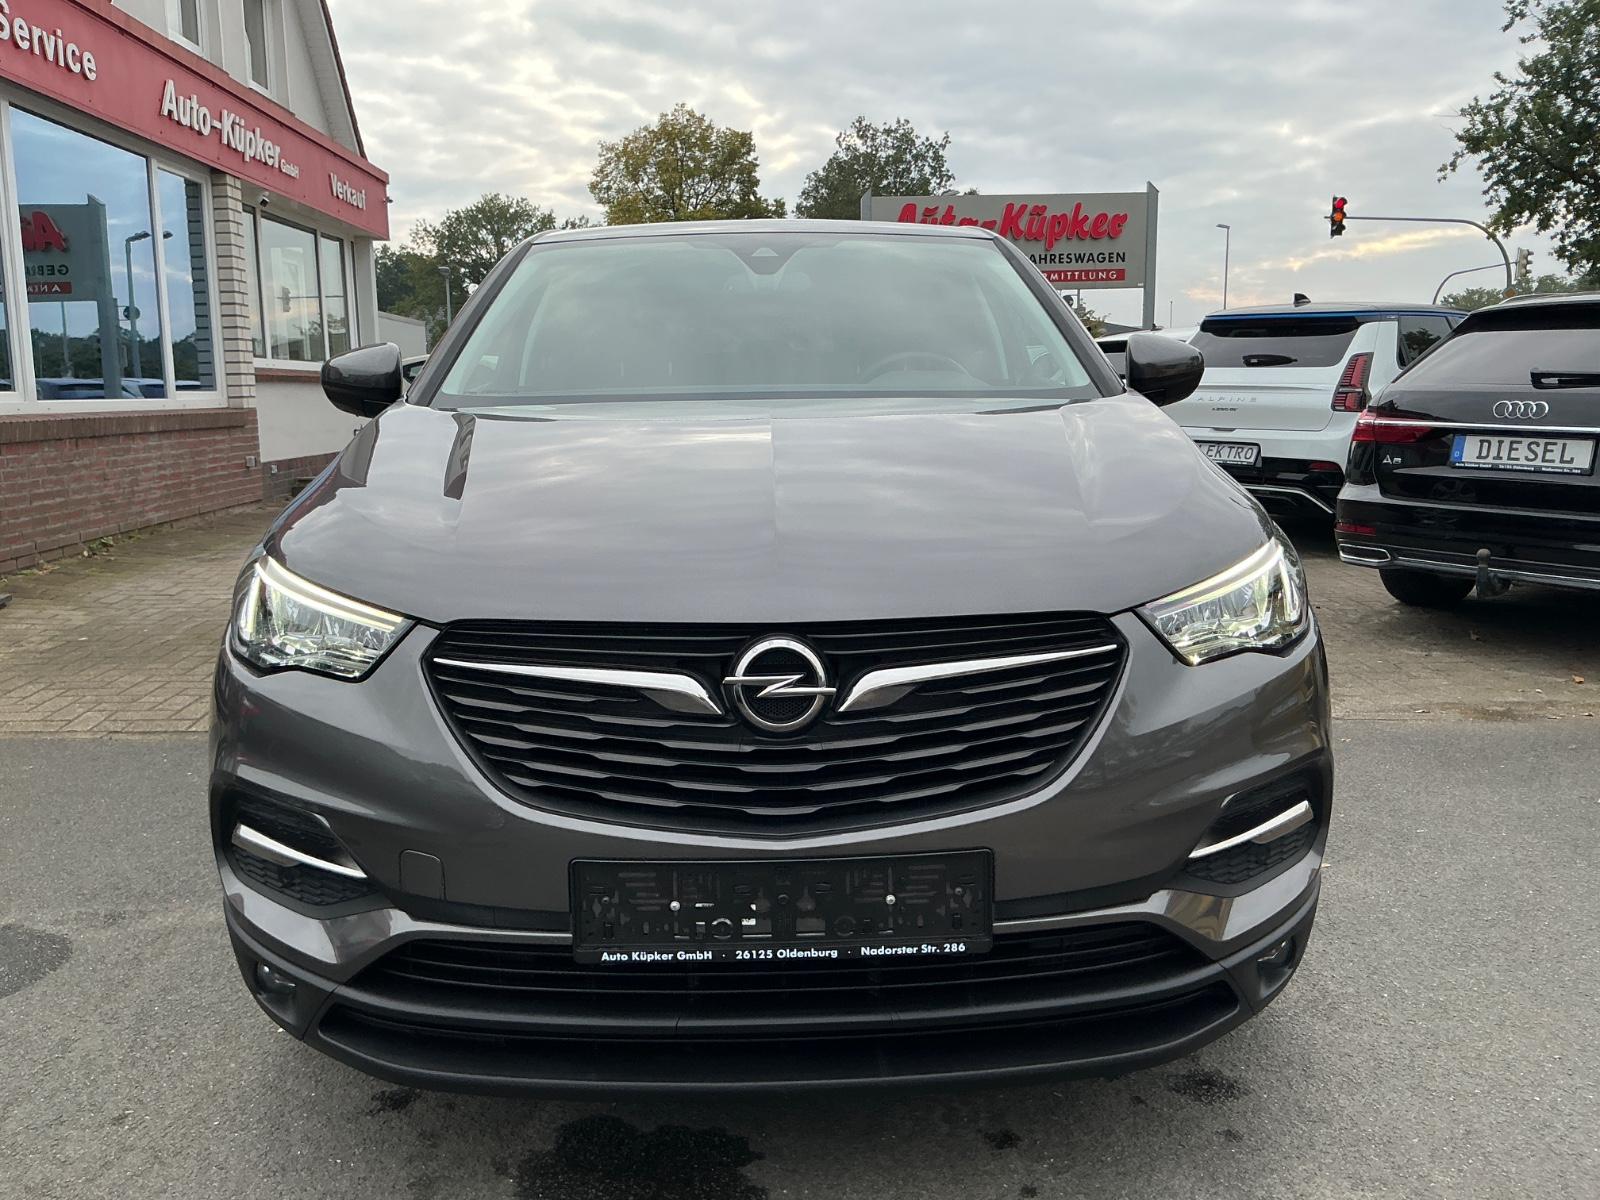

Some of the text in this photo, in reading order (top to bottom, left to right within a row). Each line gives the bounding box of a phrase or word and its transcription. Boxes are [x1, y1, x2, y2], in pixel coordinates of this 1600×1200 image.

[0, 0, 96, 80] Service
[161, 79, 299, 179] Auto-Küpker GmbH
[329, 172, 366, 210] Verkauf
[898, 202, 1128, 251] At-Küpker
[1199, 444, 1254, 460] EKTRO
[1476, 439, 1575, 464] DIESEL
[601, 943, 966, 962] Auto Küpker GmbH 26125 Oldenburg Nadorster Str. 286
